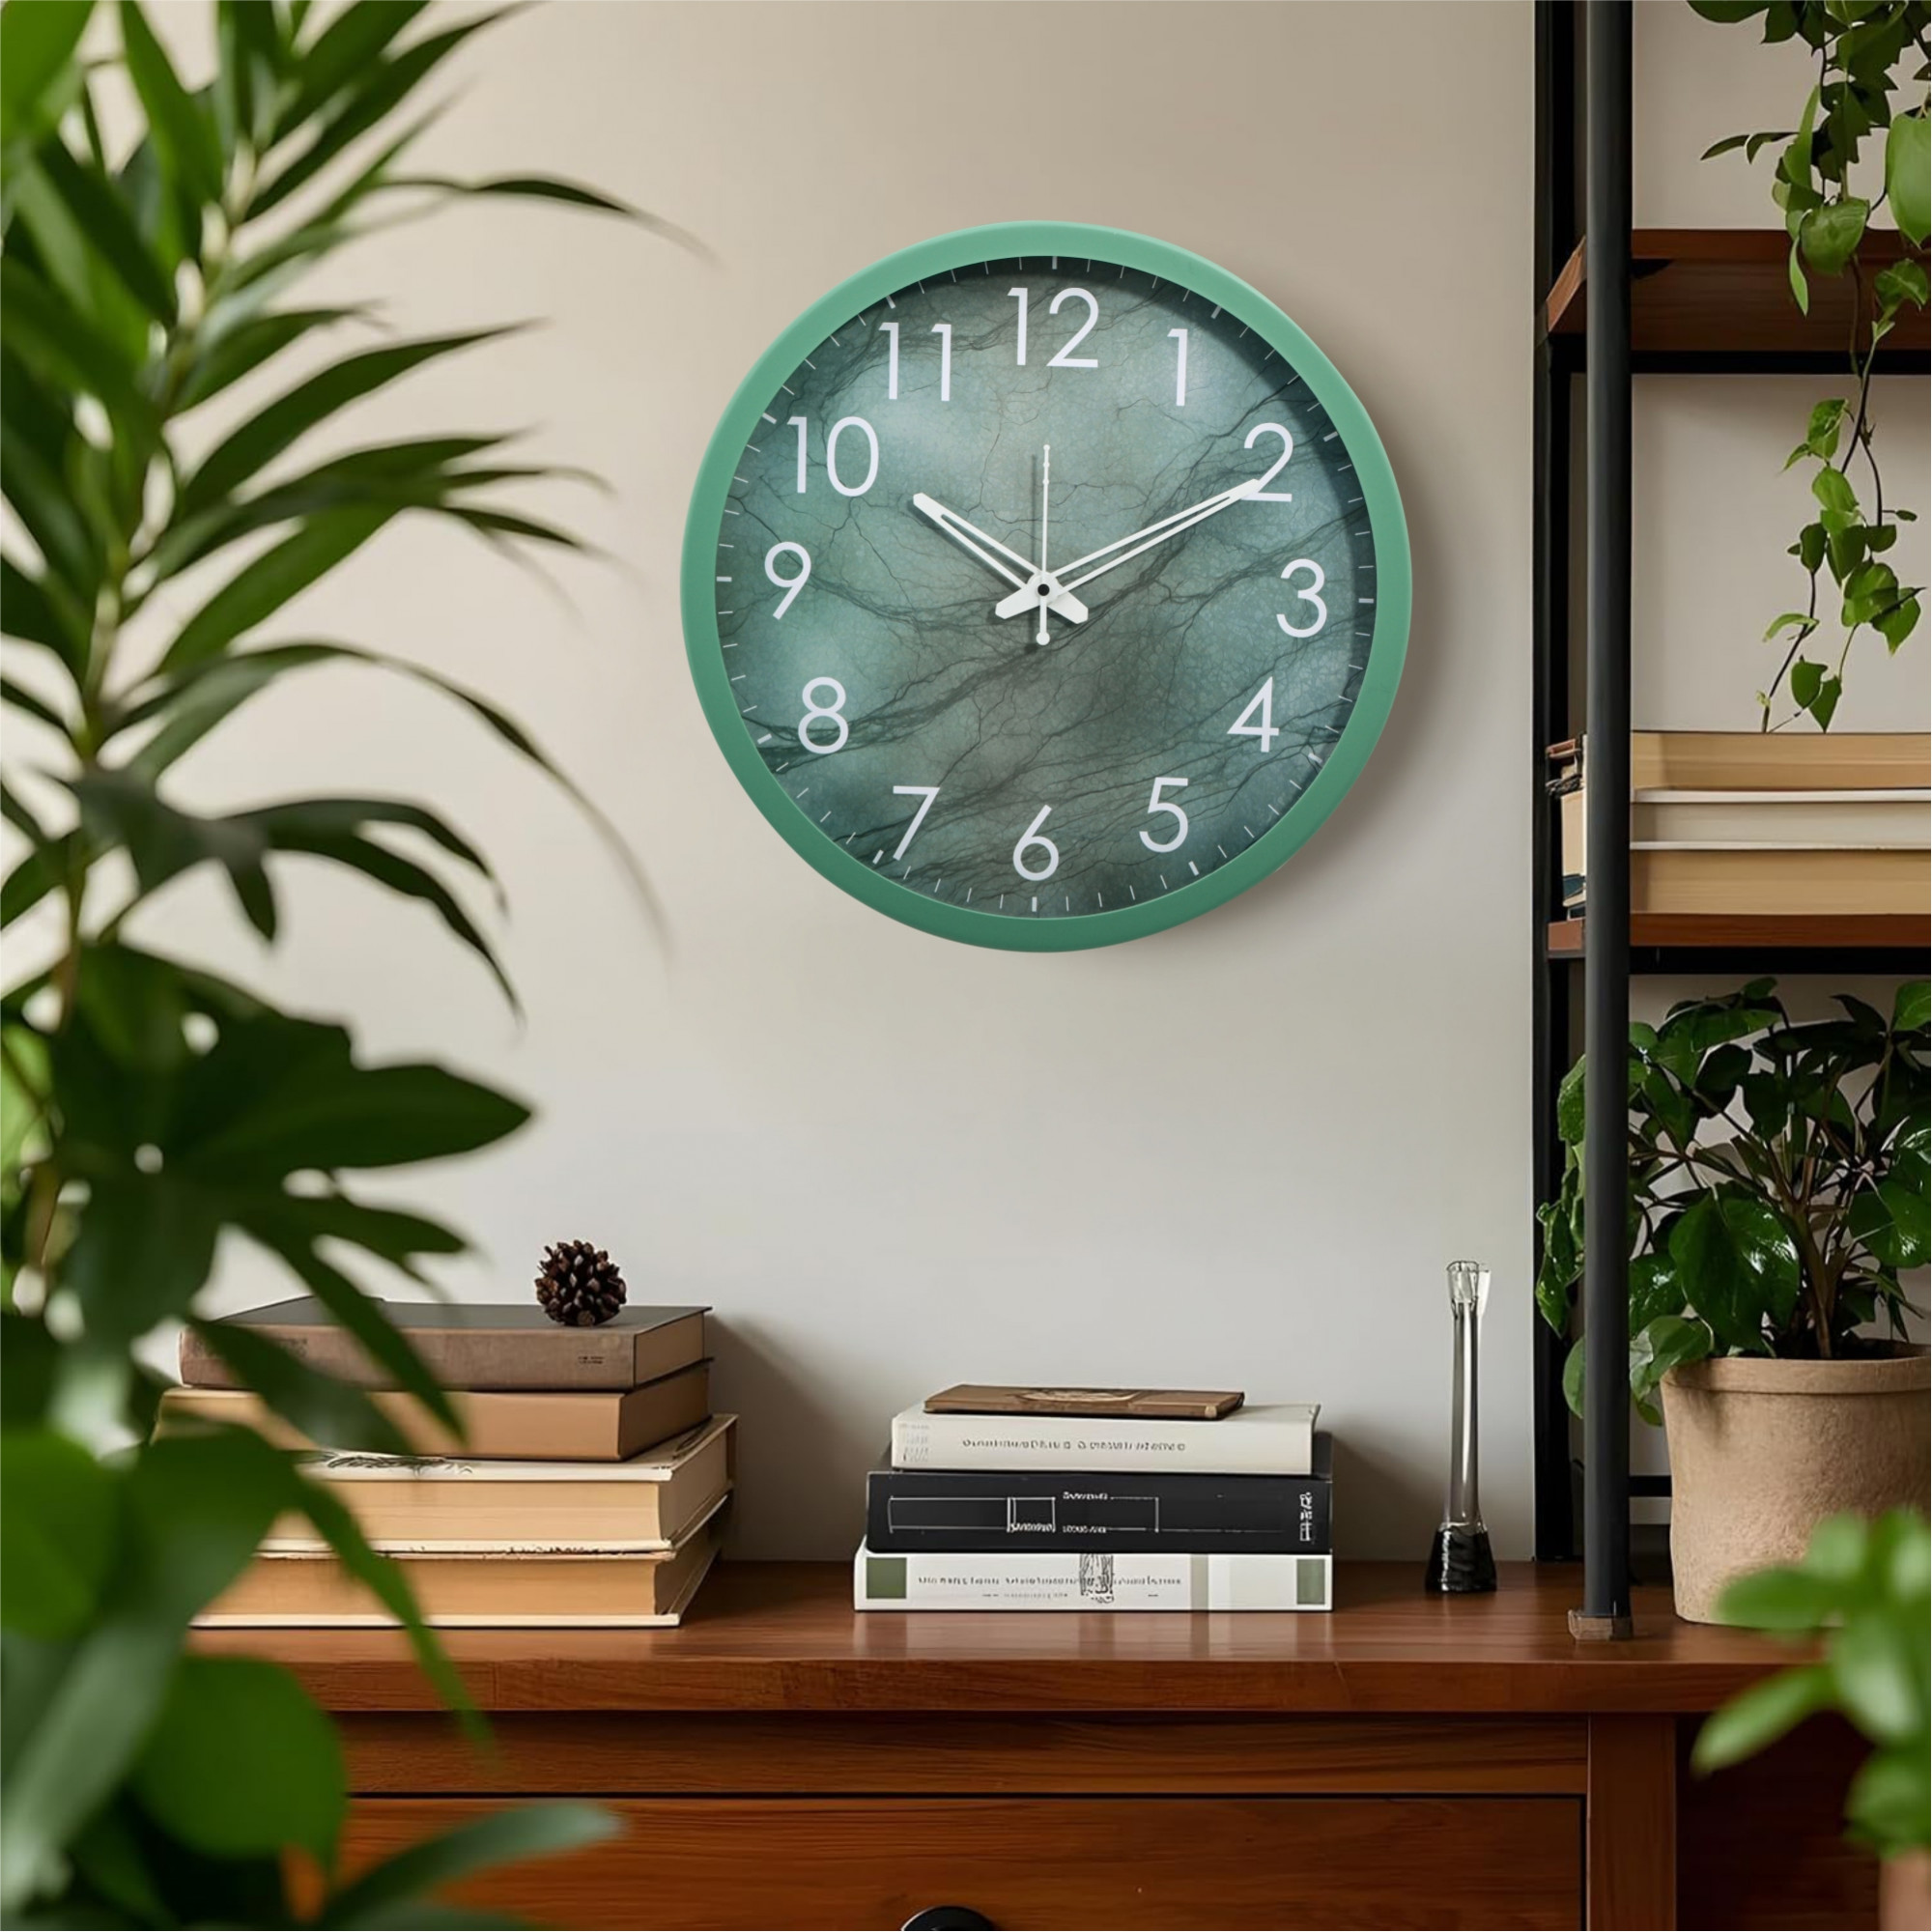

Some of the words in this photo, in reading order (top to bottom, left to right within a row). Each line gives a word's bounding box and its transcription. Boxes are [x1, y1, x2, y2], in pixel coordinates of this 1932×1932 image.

[880, 323, 952, 402] 11
[1008, 287, 1098, 368] 12
[1167, 328, 1188, 407] 1
[787, 416, 879, 497] 10
[1242, 422, 1293, 502] 2
[764, 541, 810, 619] 9
[1276, 559, 1326, 638] 3
[798, 677, 848, 753] 8
[1227, 677, 1279, 753] 4
[893, 785, 940, 860] 7
[1012, 805, 1059, 880] 6
[1139, 778, 1188, 852] 5
